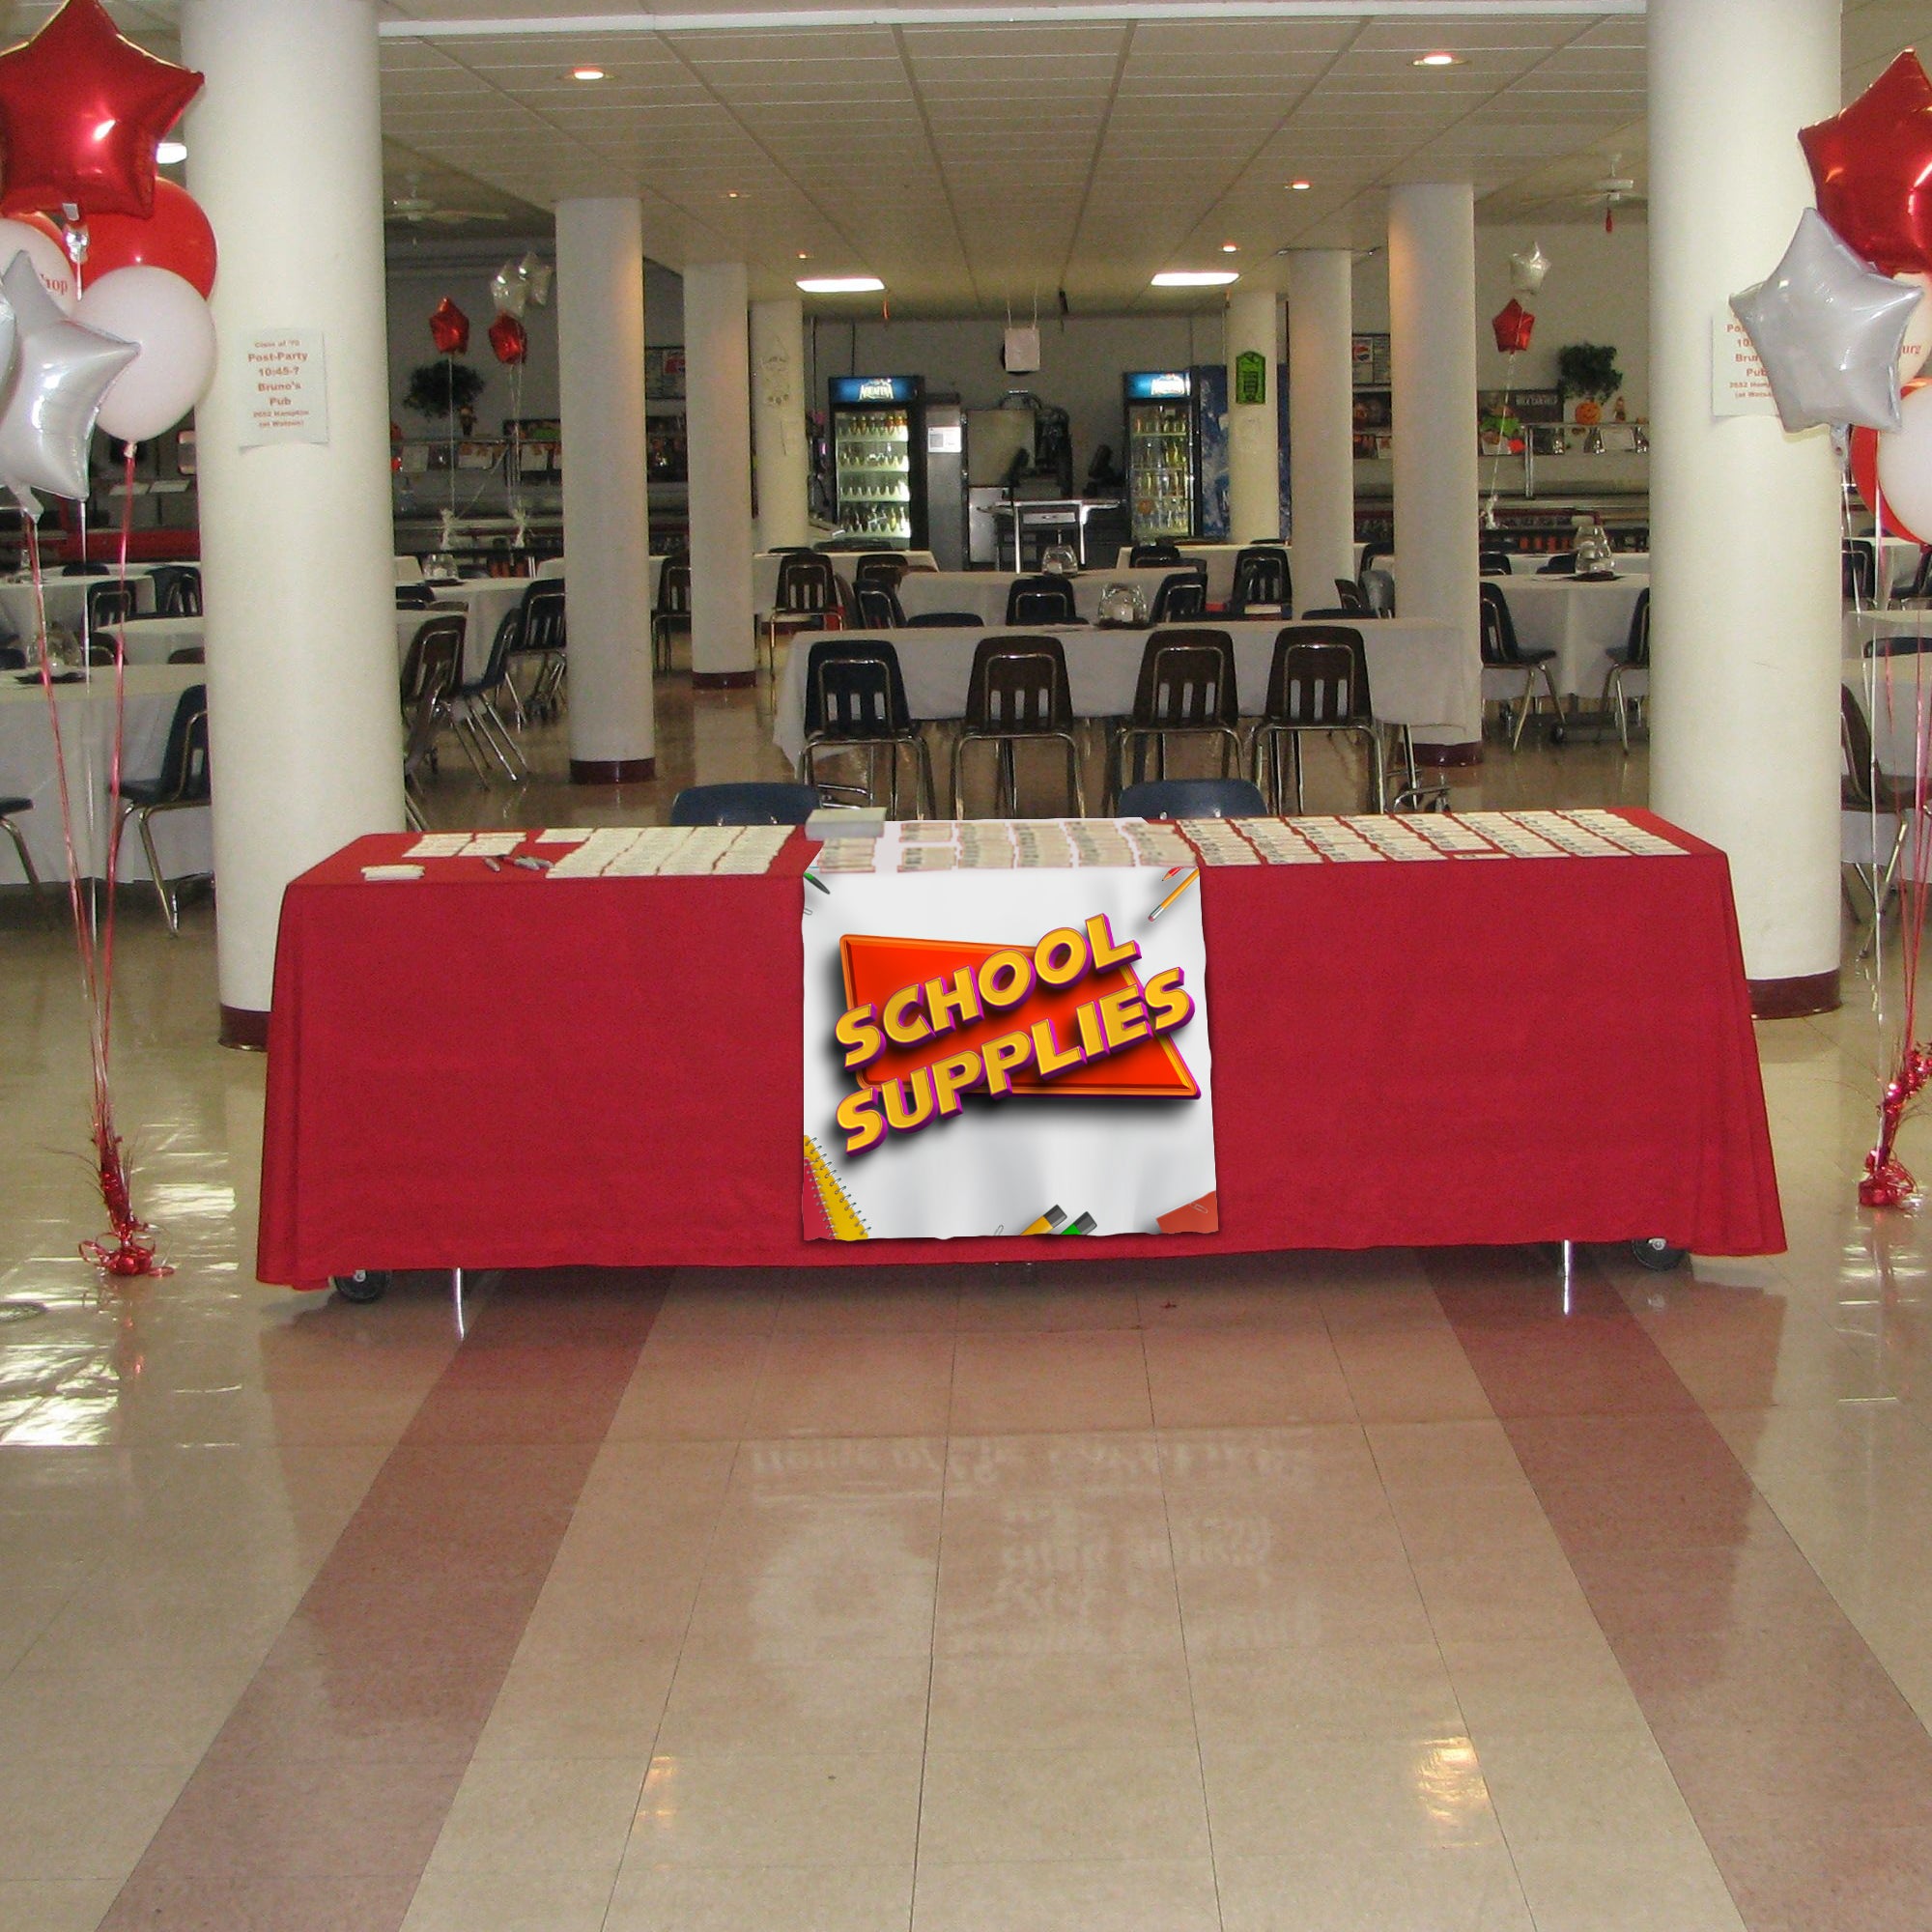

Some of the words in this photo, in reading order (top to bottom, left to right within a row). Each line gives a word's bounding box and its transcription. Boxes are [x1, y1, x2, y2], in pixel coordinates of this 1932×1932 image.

[247, 351, 308, 363] Post-Party
[1735, 354, 1762, 362] Brun
[1747, 367, 1769, 377] Pub
[258, 381, 300, 391] Bruno's
[270, 397, 291, 406] Pub
[835, 913, 1142, 1071] SCHOOL
[835, 967, 1195, 1157] SUPPLIES
